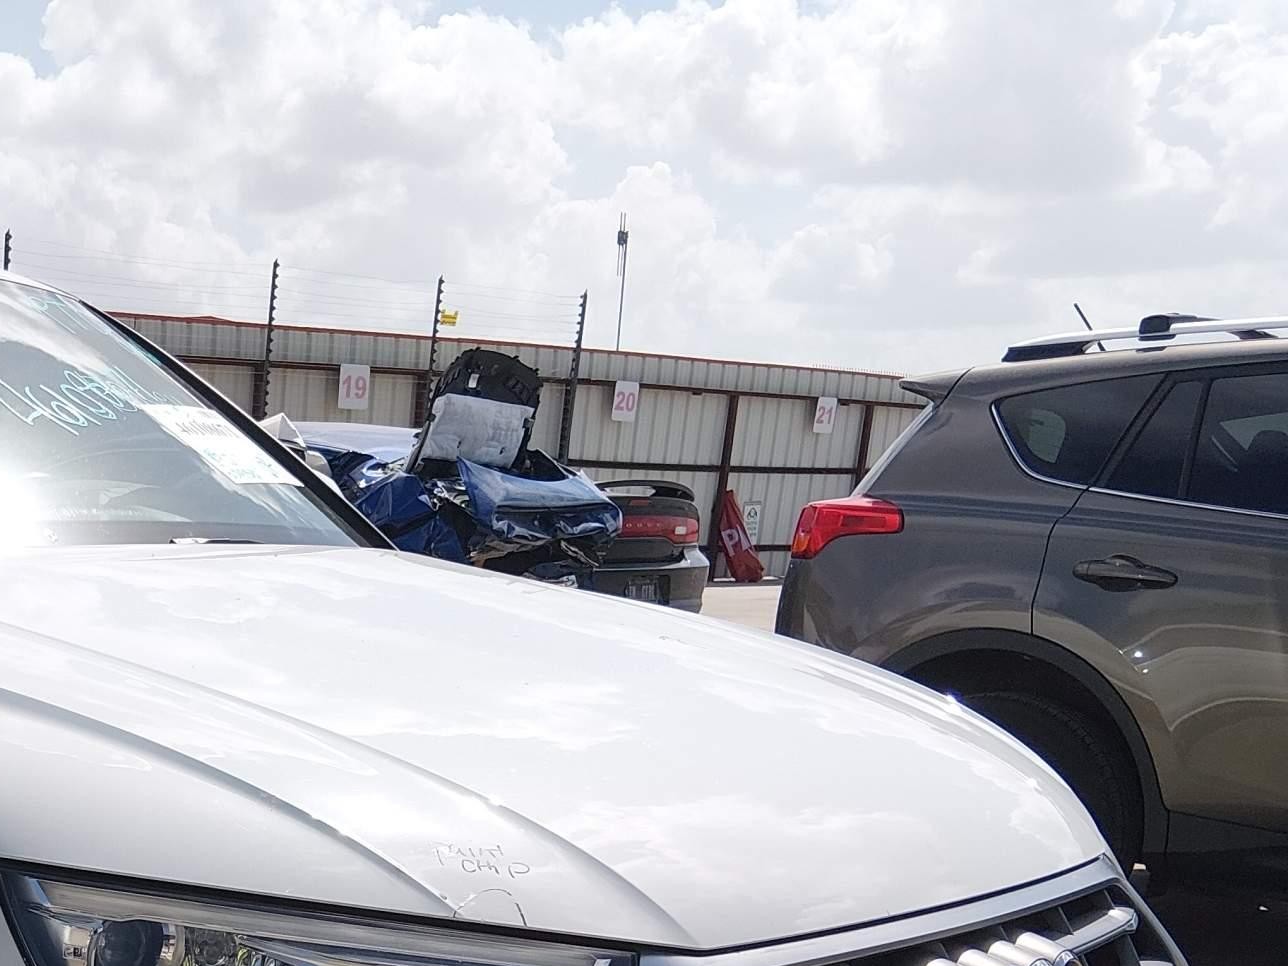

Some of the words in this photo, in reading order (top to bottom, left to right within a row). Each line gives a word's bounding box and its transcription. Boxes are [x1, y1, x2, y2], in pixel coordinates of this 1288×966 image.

[342, 375, 367, 399] 19
[615, 391, 636, 412] 20
[815, 406, 833, 425] 21
